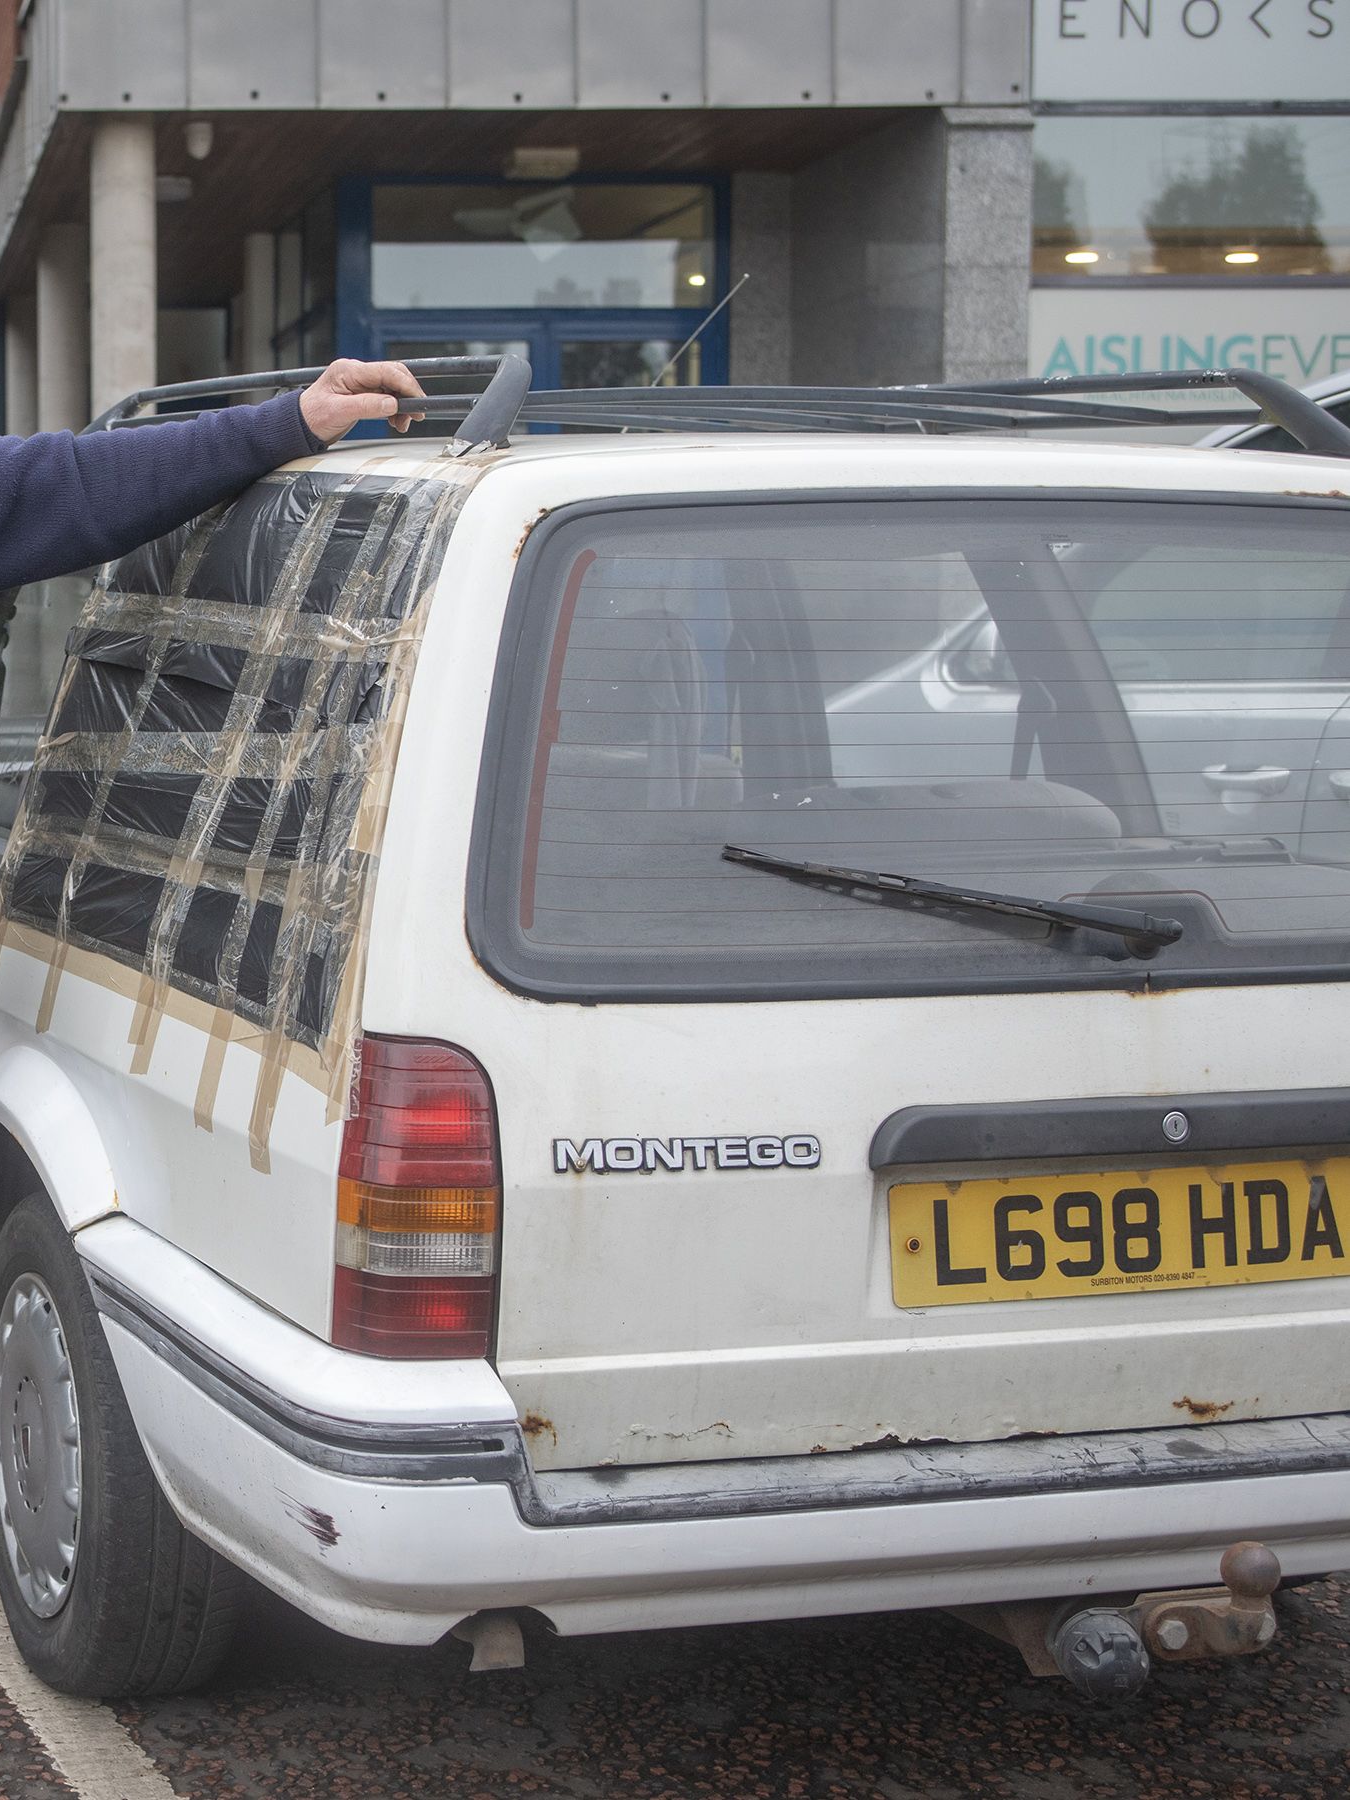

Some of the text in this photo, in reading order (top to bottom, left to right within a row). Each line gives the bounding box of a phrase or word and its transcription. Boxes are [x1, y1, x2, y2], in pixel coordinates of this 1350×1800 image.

[553, 1135, 820, 1174] MONTEGO
[933, 1175, 1345, 1287] L698 HDA
[1090, 1276, 1124, 1287] SURBITON
[1125, 1274, 1153, 1284] MOTORS
[1154, 1272, 1181, 1282] 020-8390
